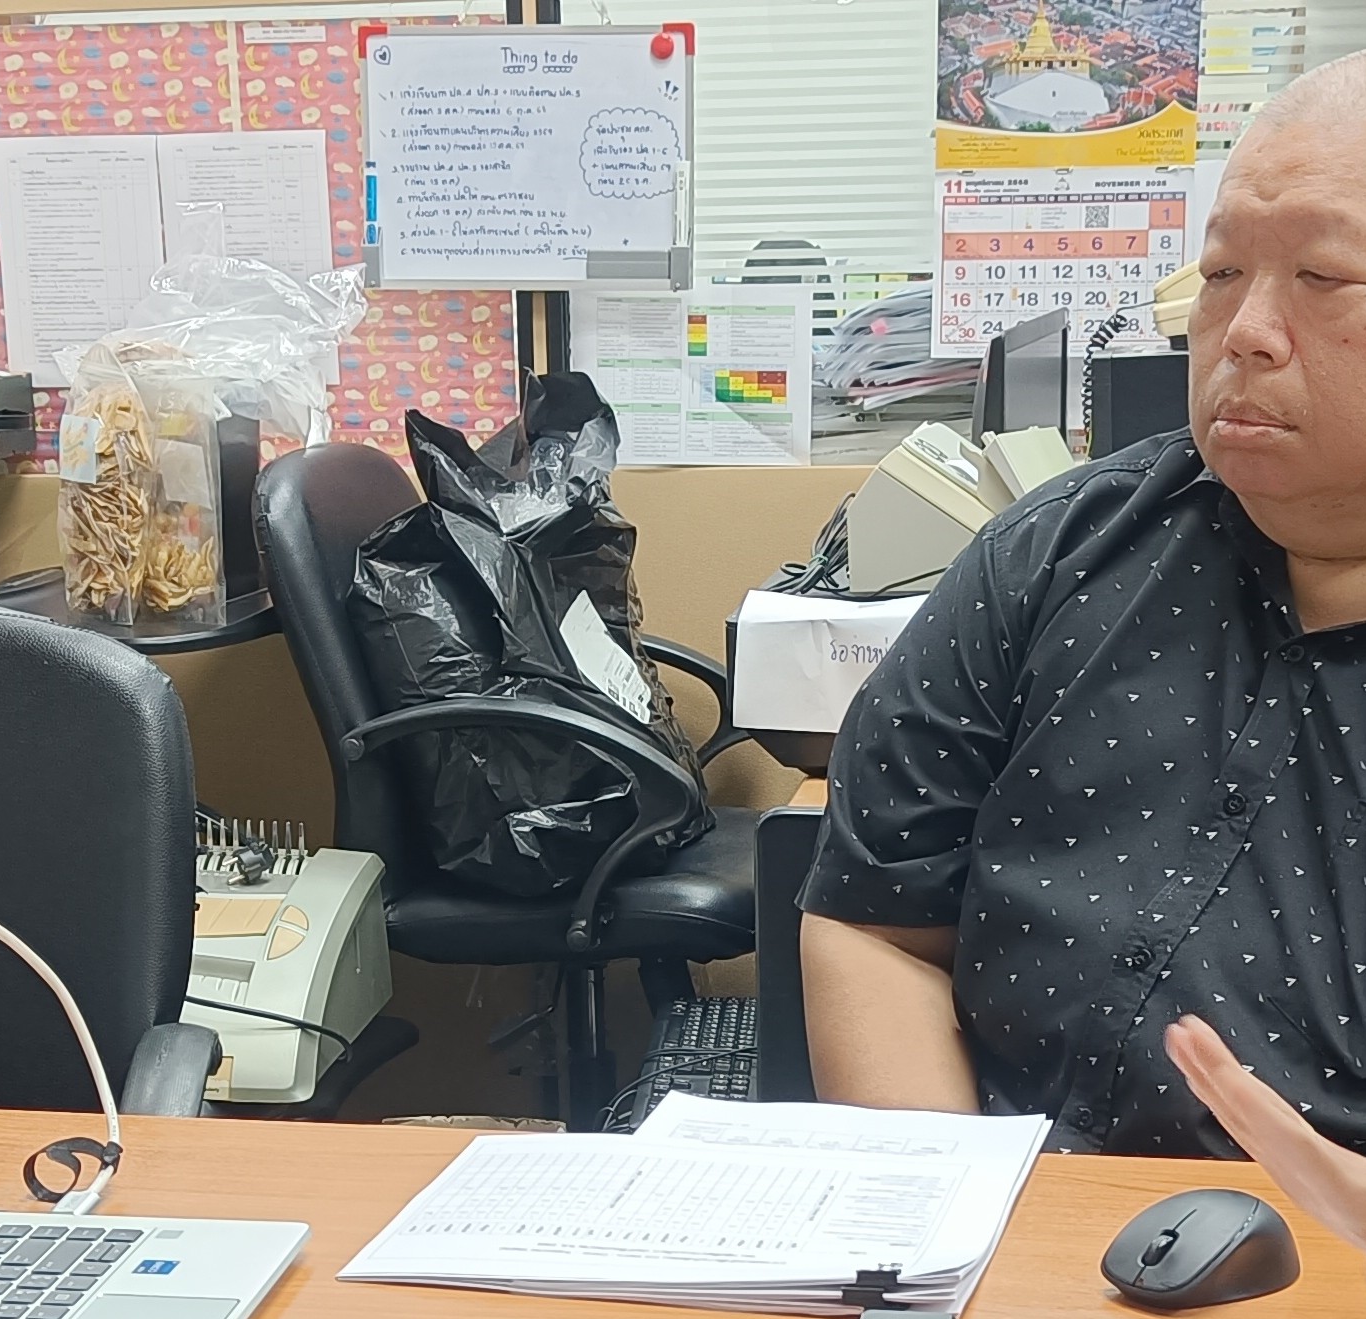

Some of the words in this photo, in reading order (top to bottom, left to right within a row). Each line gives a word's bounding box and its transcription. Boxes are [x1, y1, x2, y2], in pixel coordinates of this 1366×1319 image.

[501, 47, 538, 72] Thing
[543, 50, 557, 64] to
[562, 51, 578, 65] do
[944, 180, 962, 193] 11
[1094, 180, 1141, 188] NOVEMBER
[1163, 207, 1171, 222] 1
[956, 239, 966, 252] 2
[989, 238, 1000, 252] 3
[1023, 238, 1034, 251] 4
[1057, 237, 1069, 251] 5
[1091, 236, 1103, 250] 6
[1126, 236, 1137, 249] 7
[1160, 235, 1172, 249] 8
[955, 266, 966, 280] 9
[985, 265, 1006, 280] 10
[1018, 265, 1037, 279] 11
[1052, 264, 1073, 278] 12
[1086, 264, 1107, 278] 13
[1120, 264, 1142, 278] 14
[1155, 262, 1176, 277] 15
[950, 292, 971, 307] 16
[984, 292, 1005, 306] 17
[1017, 292, 1039, 306] 18
[1051, 291, 1073, 305] 19
[1084, 291, 1106, 305] 20
[1119, 290, 1139, 305] 21
[942, 315, 958, 326] 23
[982, 320, 1004, 335] 24
[958, 327, 975, 338] 30
